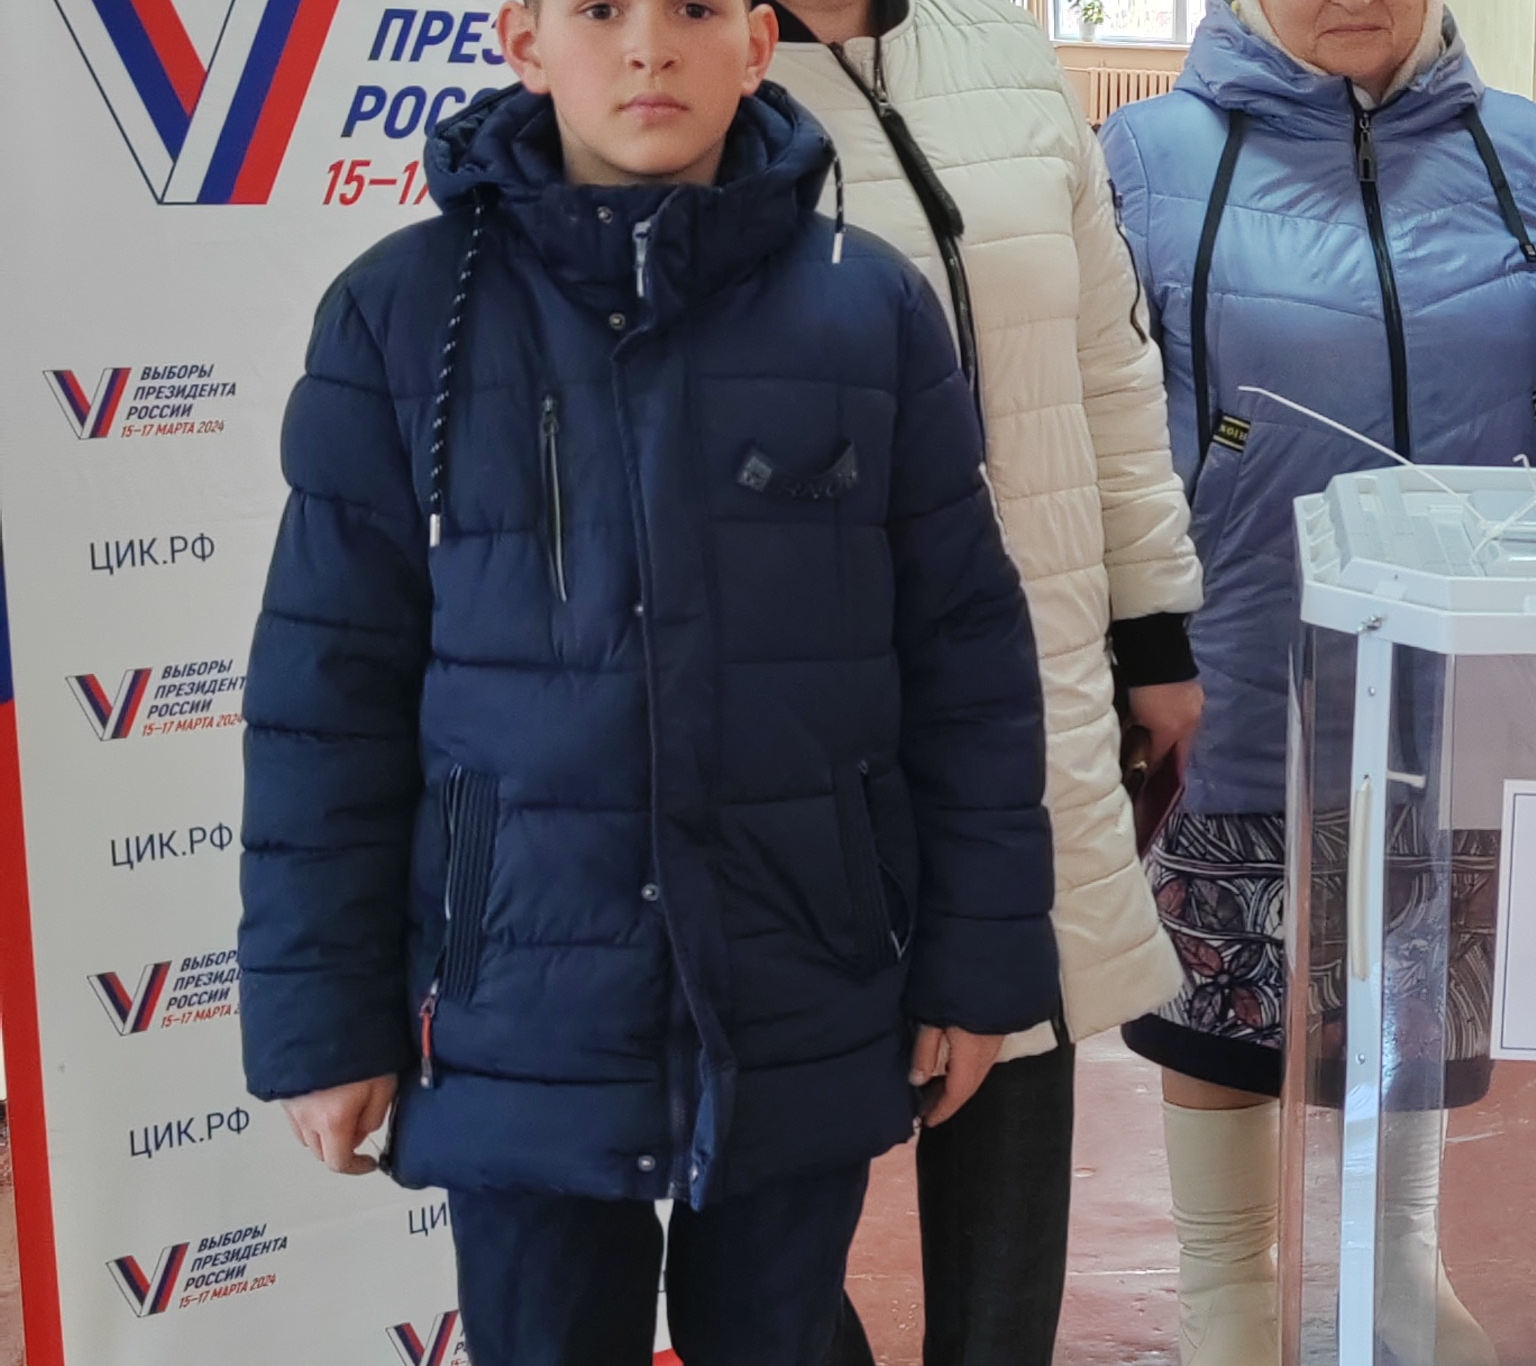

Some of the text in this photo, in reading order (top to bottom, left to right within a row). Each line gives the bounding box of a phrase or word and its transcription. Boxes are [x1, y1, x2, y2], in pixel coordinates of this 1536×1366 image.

[140, 364, 215, 382] ВЫБОРЫ
[133, 381, 237, 401] ПРЕЗИДЕНТА
[126, 403, 193, 421] РОССИИ
[155, 422, 195, 436] МАРТА
[196, 420, 225, 434] 2024
[90, 534, 216, 575] ЦИК.РФ
[162, 659, 233, 680] ВЫБОРЫ
[147, 699, 212, 719] РОССИИ
[175, 718, 214, 733] МАРТА
[111, 822, 233, 870] ЦИК.РФ
[180, 949, 239, 972] ВЫБОР
[166, 988, 231, 1011] РОССИИ
[193, 1004, 232, 1022] МАРТА
[129, 1108, 250, 1158] ЦИК.РФ
[197, 1223, 268, 1254] ВЫБОРЫ
[189, 1235, 289, 1273] ПРЕЗИДЕНТА
[183, 1264, 247, 1292] РОССИИ
[210, 1280, 249, 1302] МАРТА
[250, 1272, 277, 1291] 2024
